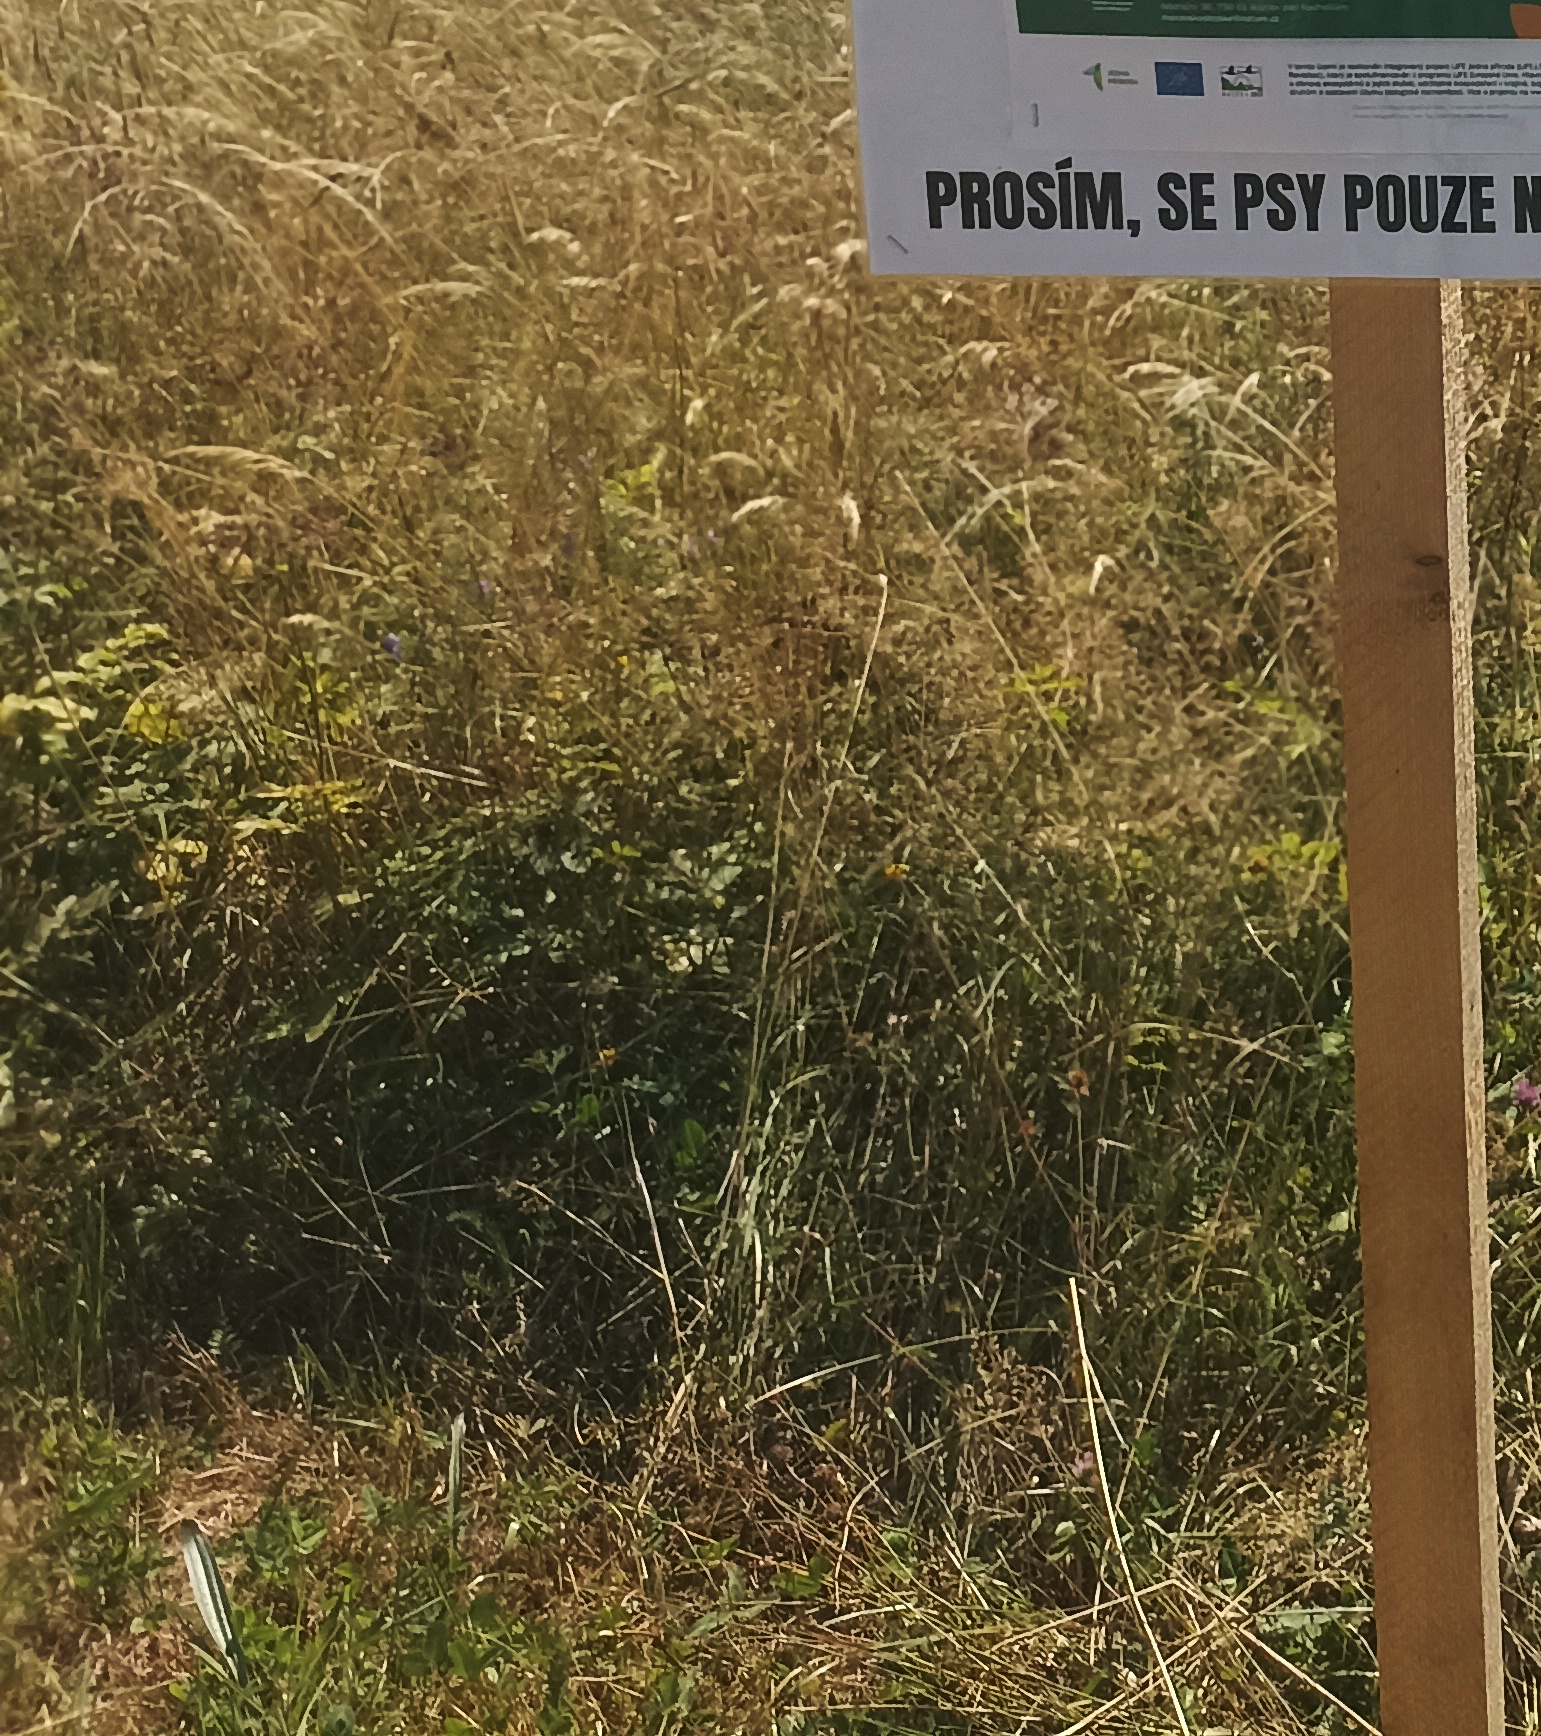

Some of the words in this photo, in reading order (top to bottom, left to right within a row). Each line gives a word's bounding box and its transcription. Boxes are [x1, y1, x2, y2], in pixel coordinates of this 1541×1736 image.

[925, 155, 1140, 238] PROSÍM,
[1157, 172, 1217, 231] SE
[1233, 172, 1325, 232] PSY
[1343, 173, 1496, 233] POUZE
